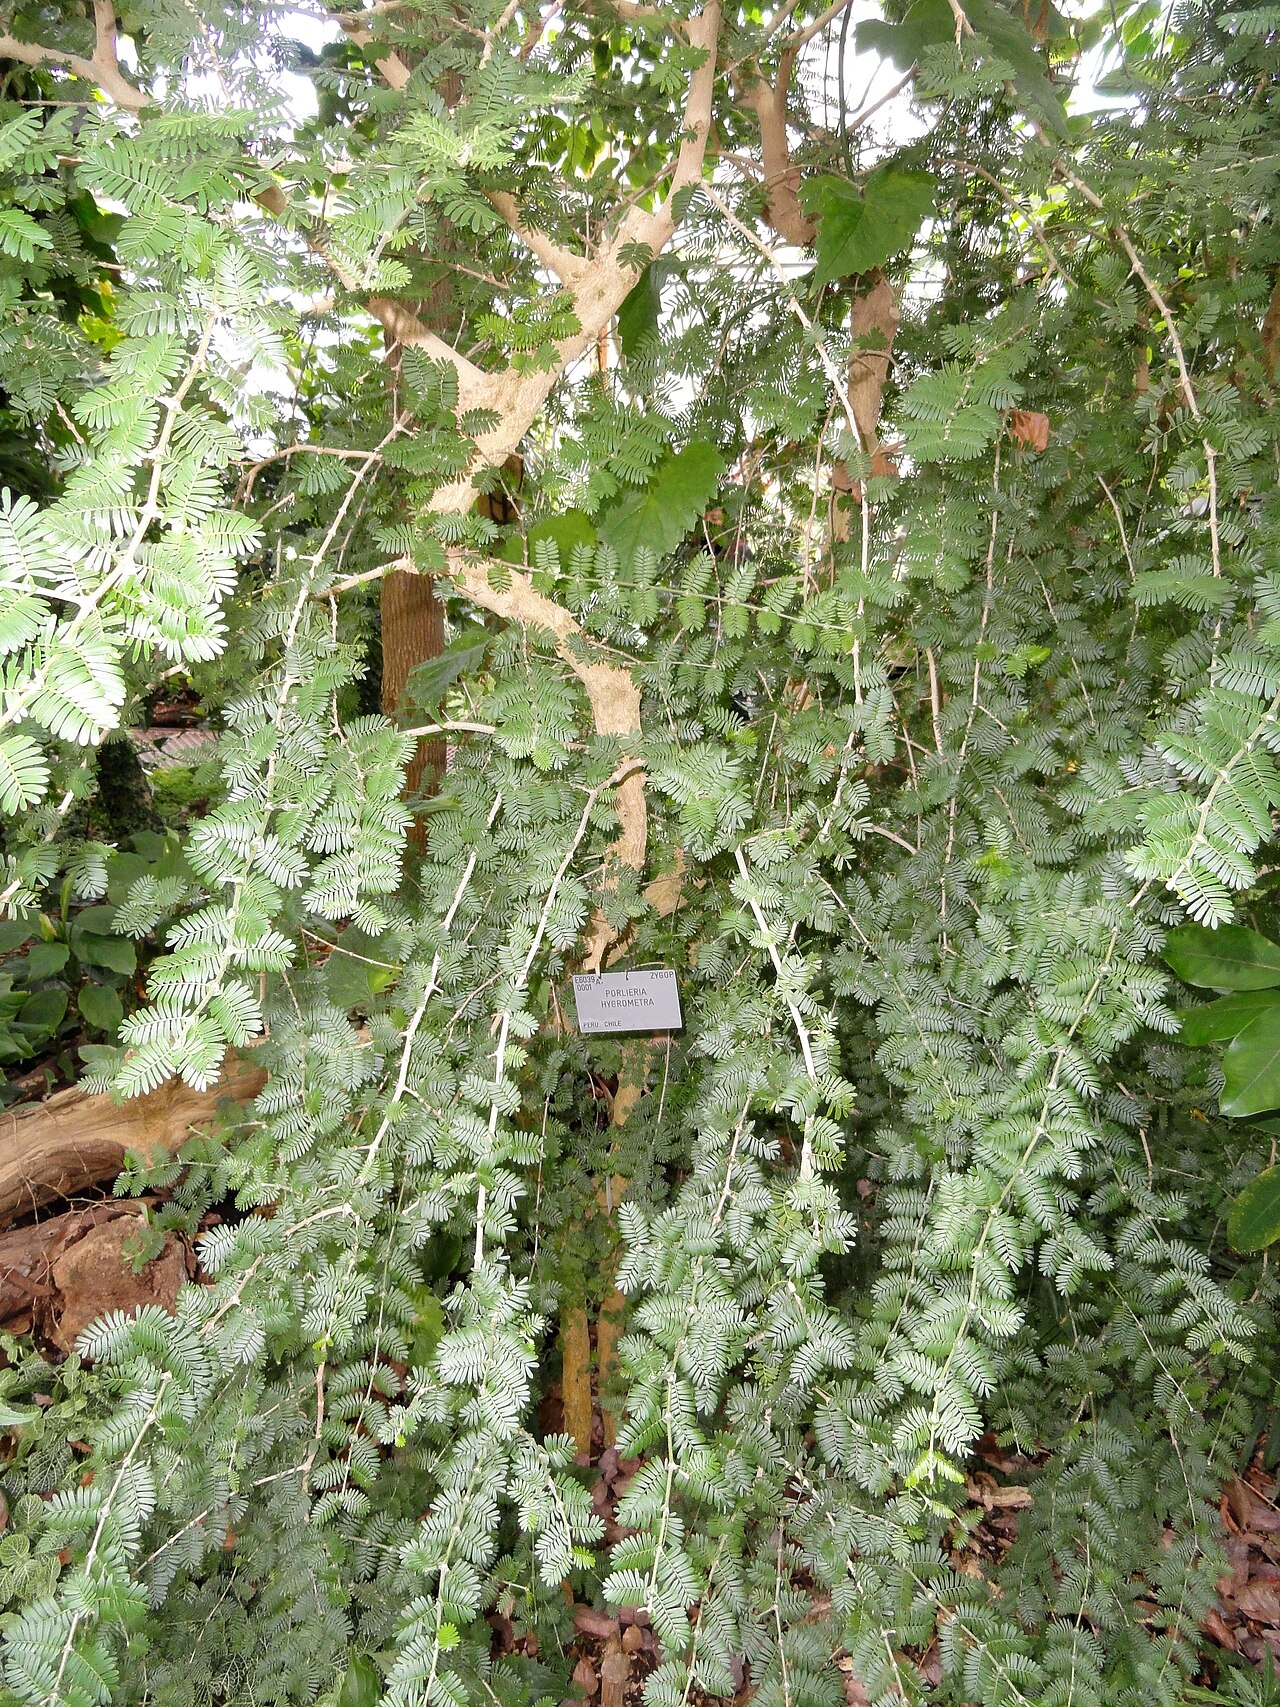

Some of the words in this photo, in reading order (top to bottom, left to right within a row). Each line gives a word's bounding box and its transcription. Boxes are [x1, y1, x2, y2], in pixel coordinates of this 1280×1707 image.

[650, 971, 674, 979] ZYGOP
[605, 988, 647, 997] PORLIERIA
[601, 998, 654, 1008] HYGROMETRA
